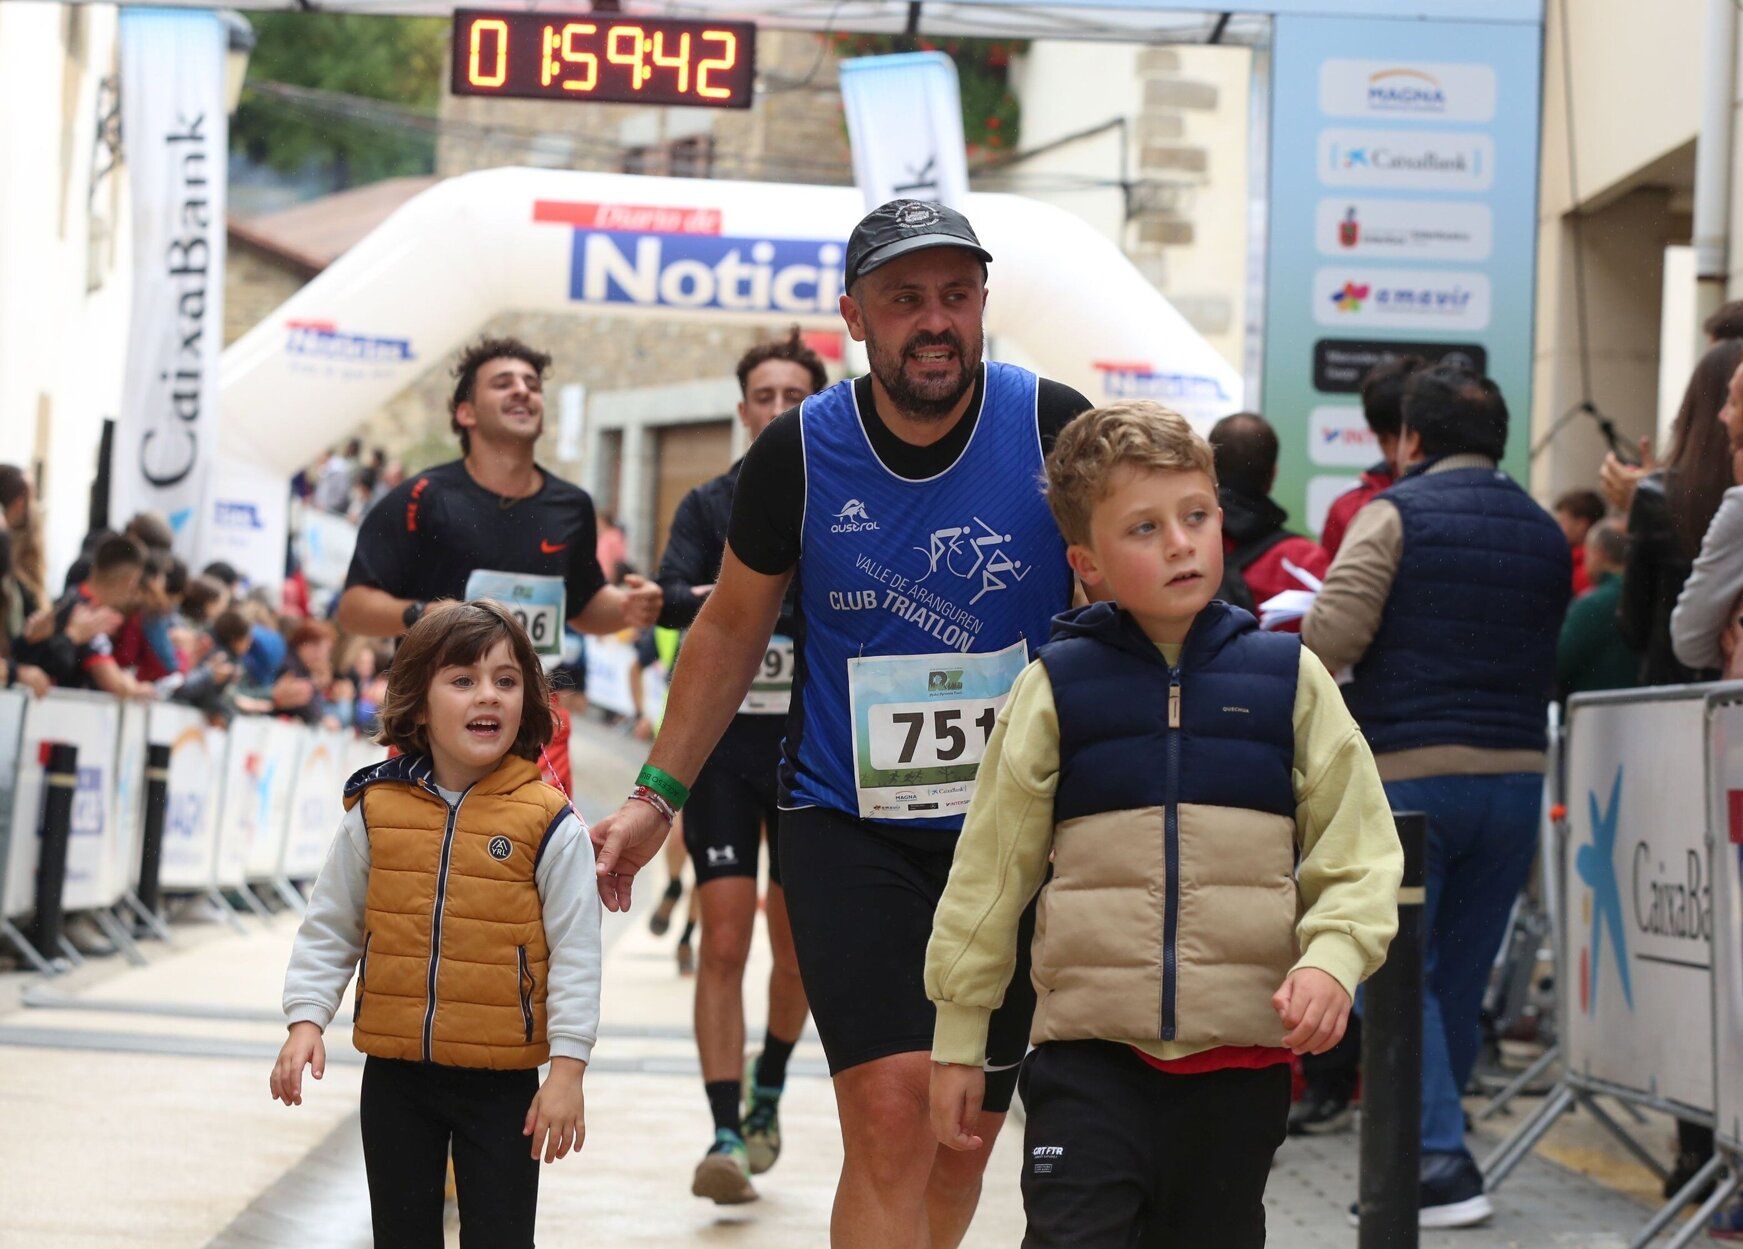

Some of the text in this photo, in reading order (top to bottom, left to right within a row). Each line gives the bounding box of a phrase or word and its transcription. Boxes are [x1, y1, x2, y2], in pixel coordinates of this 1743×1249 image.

[139, 113, 210, 489] CaixaBank
[829, 589, 975, 654] CLUB TRIATLON
[854, 552, 984, 634] VALLE DE ARANGUREN
[892, 707, 996, 764] 751
[1222, 706, 1250, 714] QUECHUA
[1046, 1146, 1064, 1156] FTR
